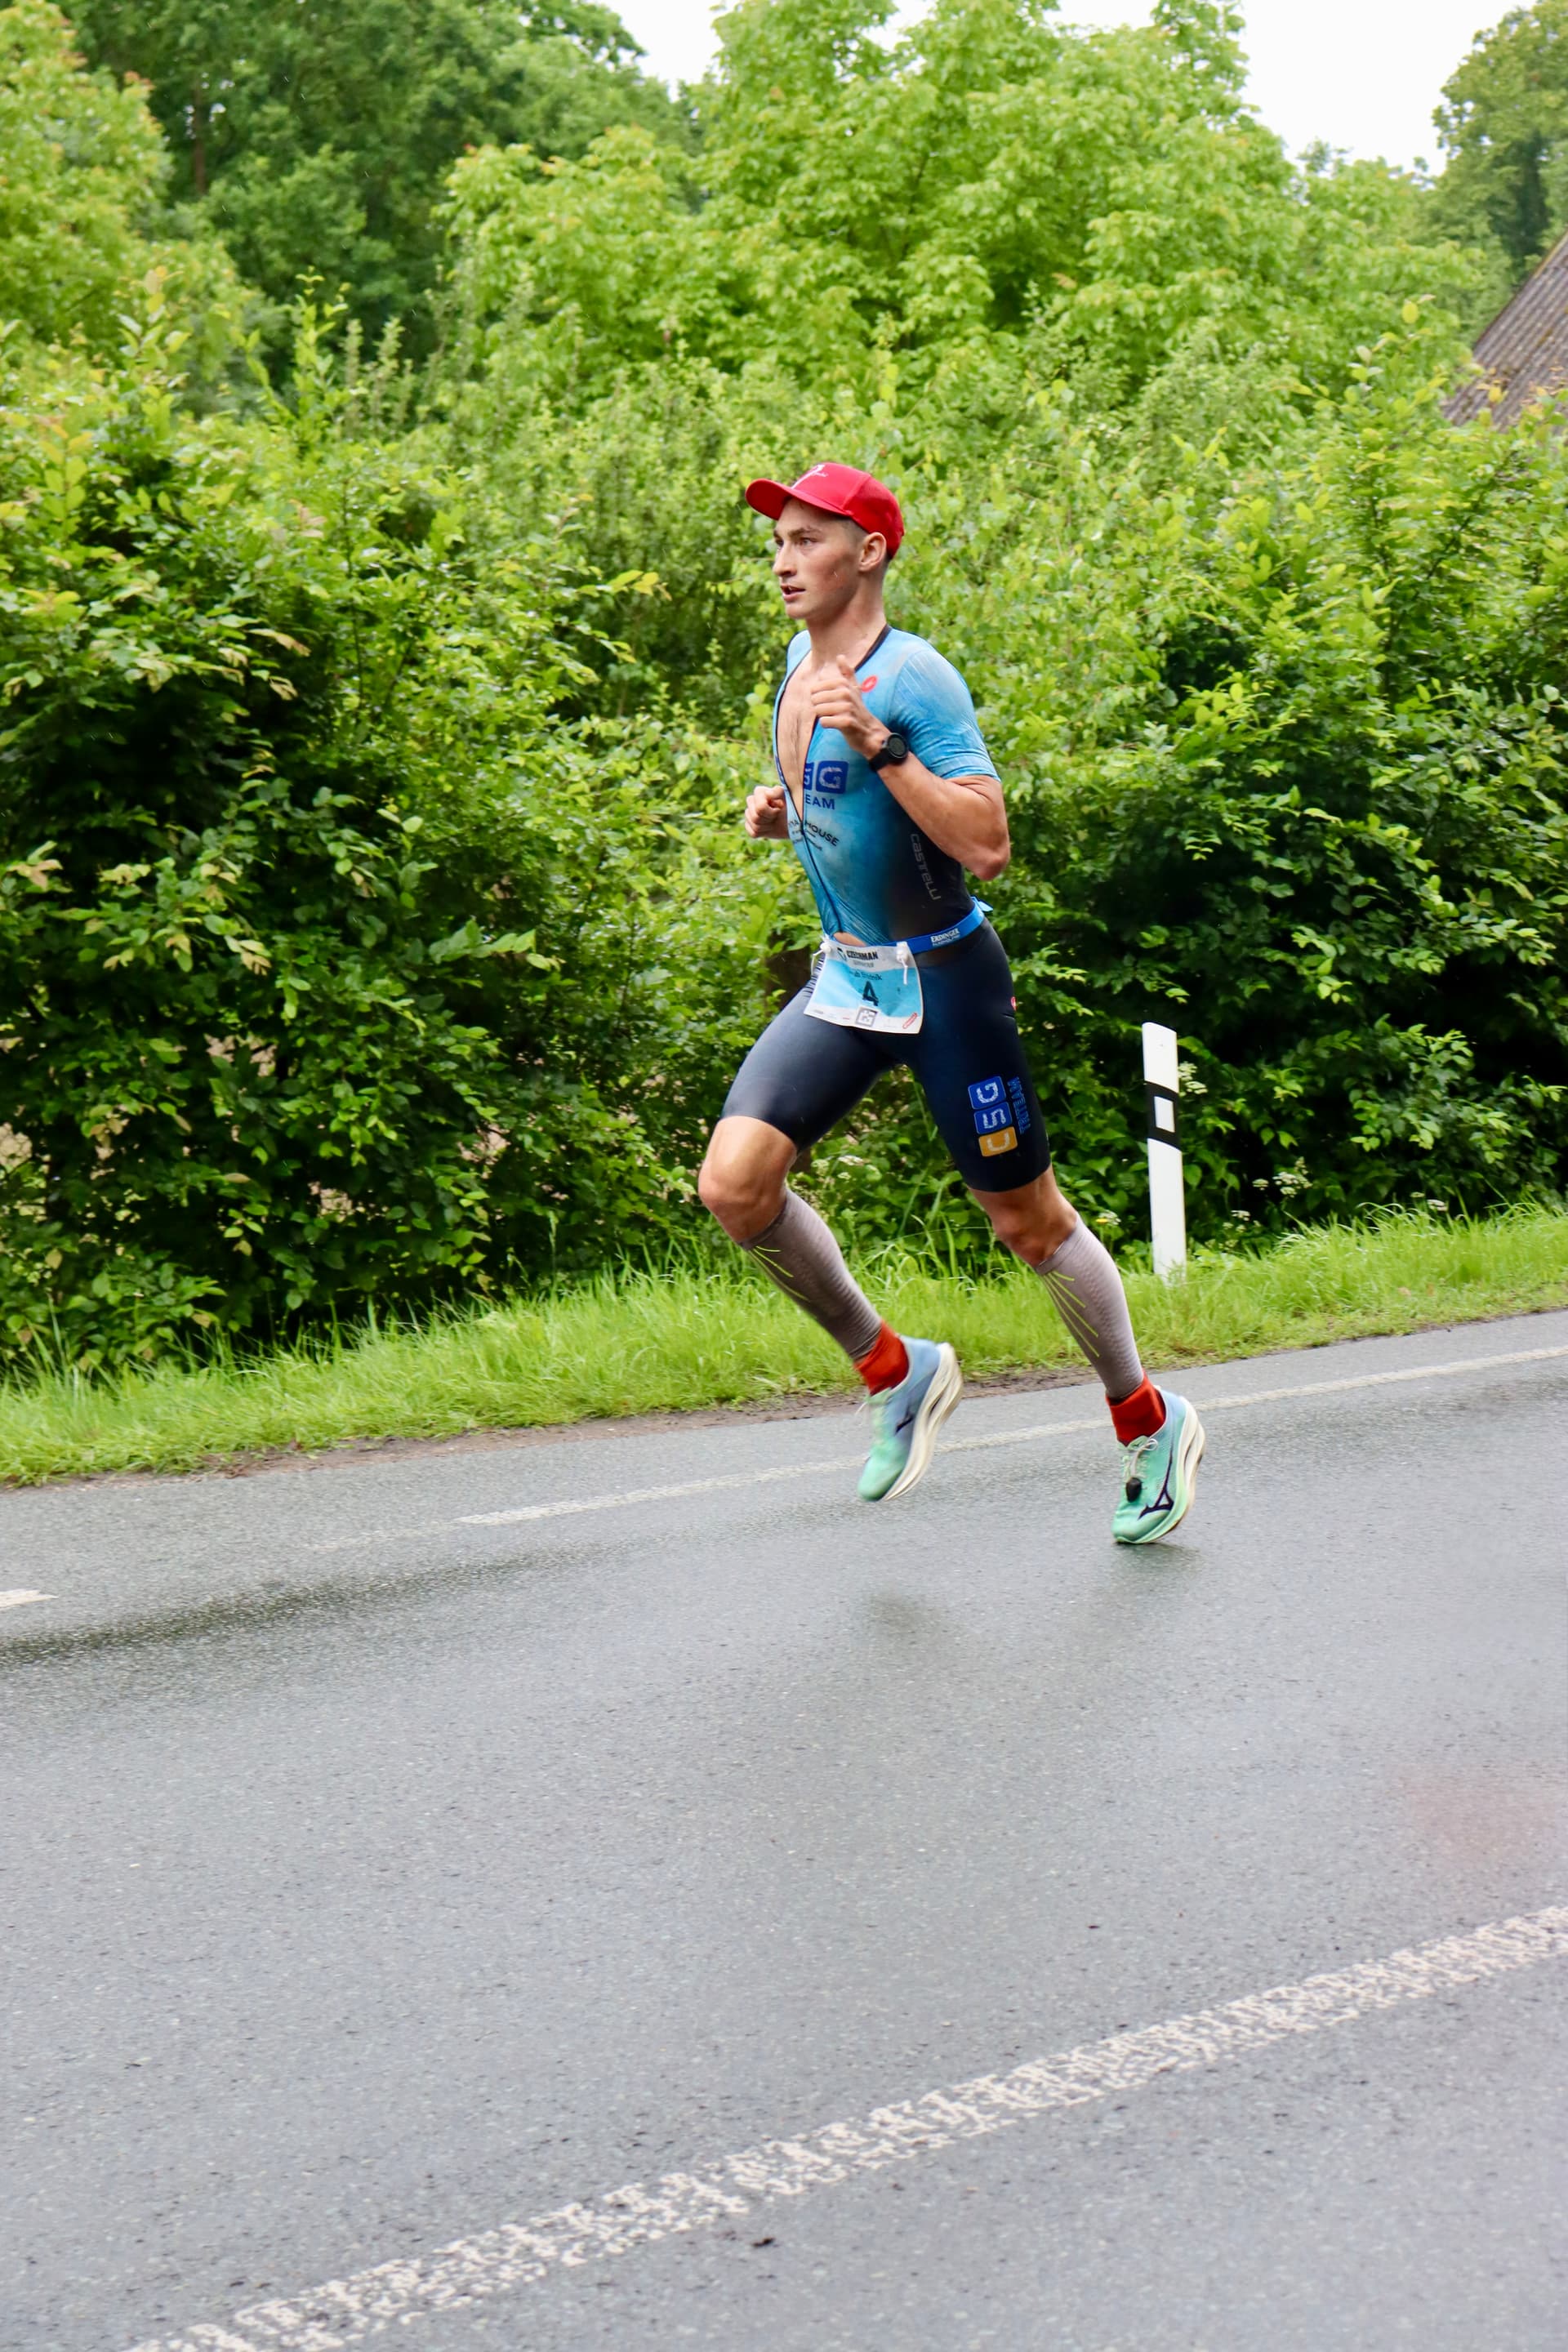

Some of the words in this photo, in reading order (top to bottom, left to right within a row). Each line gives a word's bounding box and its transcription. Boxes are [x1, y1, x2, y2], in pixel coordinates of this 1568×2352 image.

[804, 794, 835, 810] EAM
[804, 820, 840, 847] HOUSE
[862, 980, 880, 1007] 4
